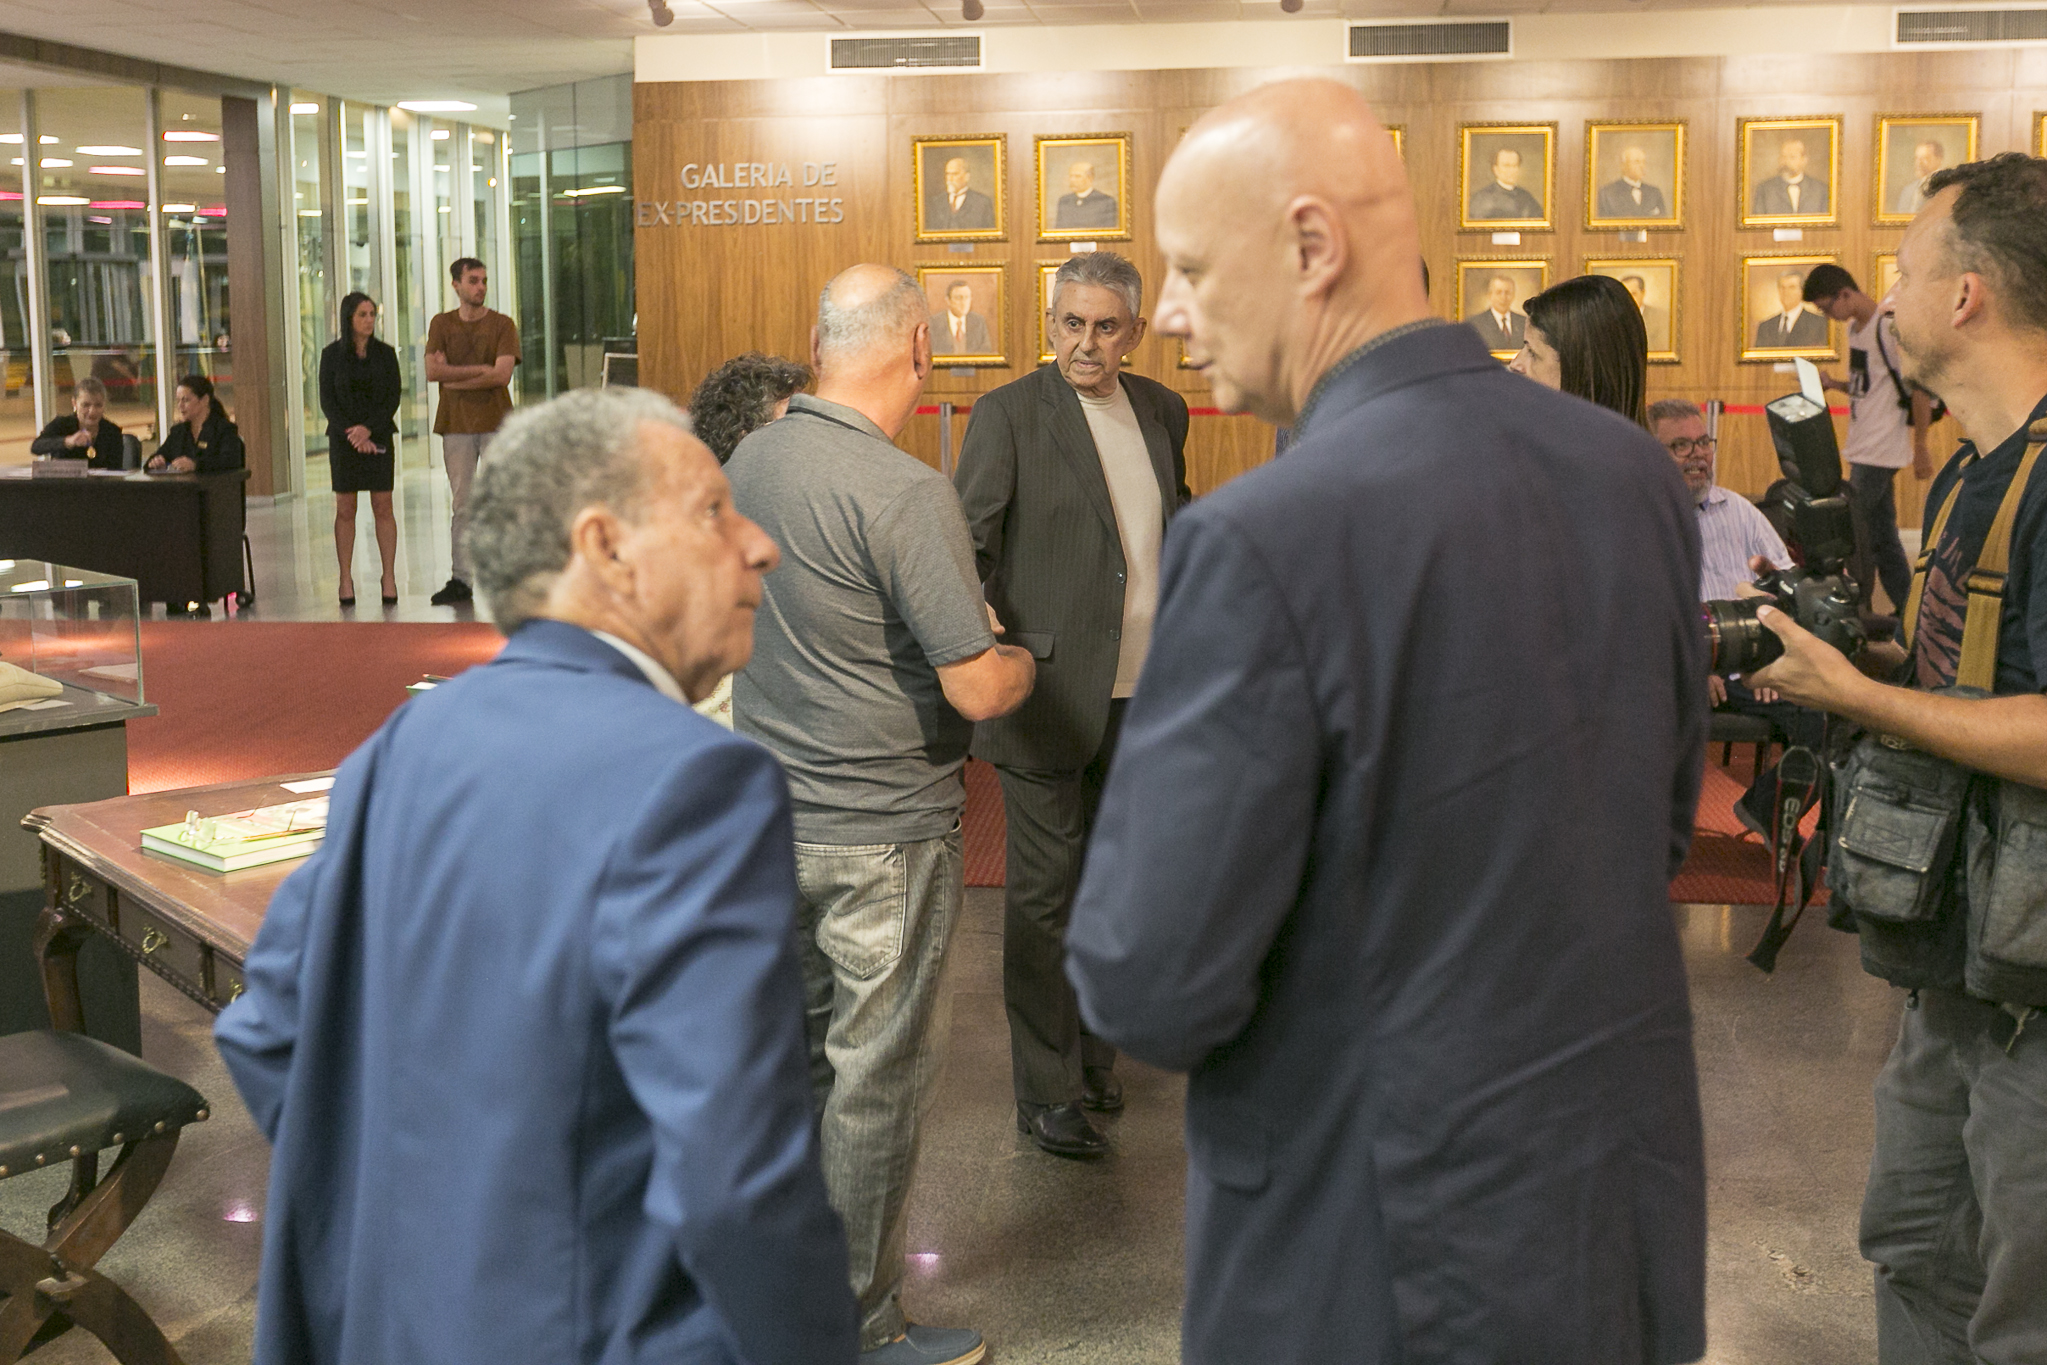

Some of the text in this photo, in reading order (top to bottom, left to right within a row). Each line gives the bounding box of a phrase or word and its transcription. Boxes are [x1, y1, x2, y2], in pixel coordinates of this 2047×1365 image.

[681, 161, 837, 190] GALERIA DE
[637, 198, 844, 226] EX-PRESIDENTES
